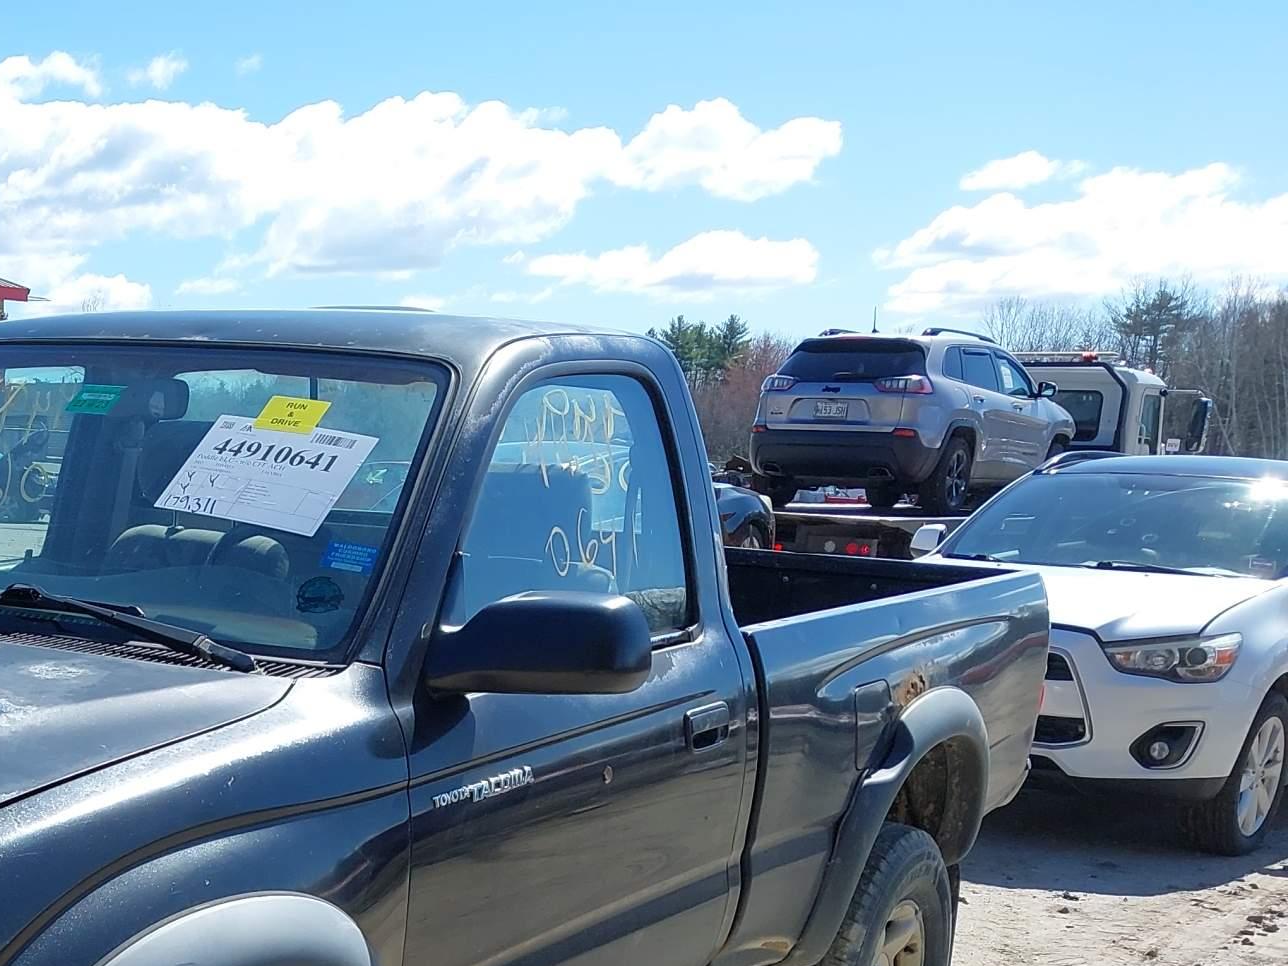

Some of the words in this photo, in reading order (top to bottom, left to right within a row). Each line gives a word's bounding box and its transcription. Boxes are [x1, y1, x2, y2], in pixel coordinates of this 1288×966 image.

[286, 402, 308, 410] RUN
[270, 418, 302, 428] DRIVE
[213, 438, 340, 473] 44910641
[209, 473, 220, 487] Y
[432, 784, 472, 808] TOYOTA
[472, 765, 535, 802] TACOMA
